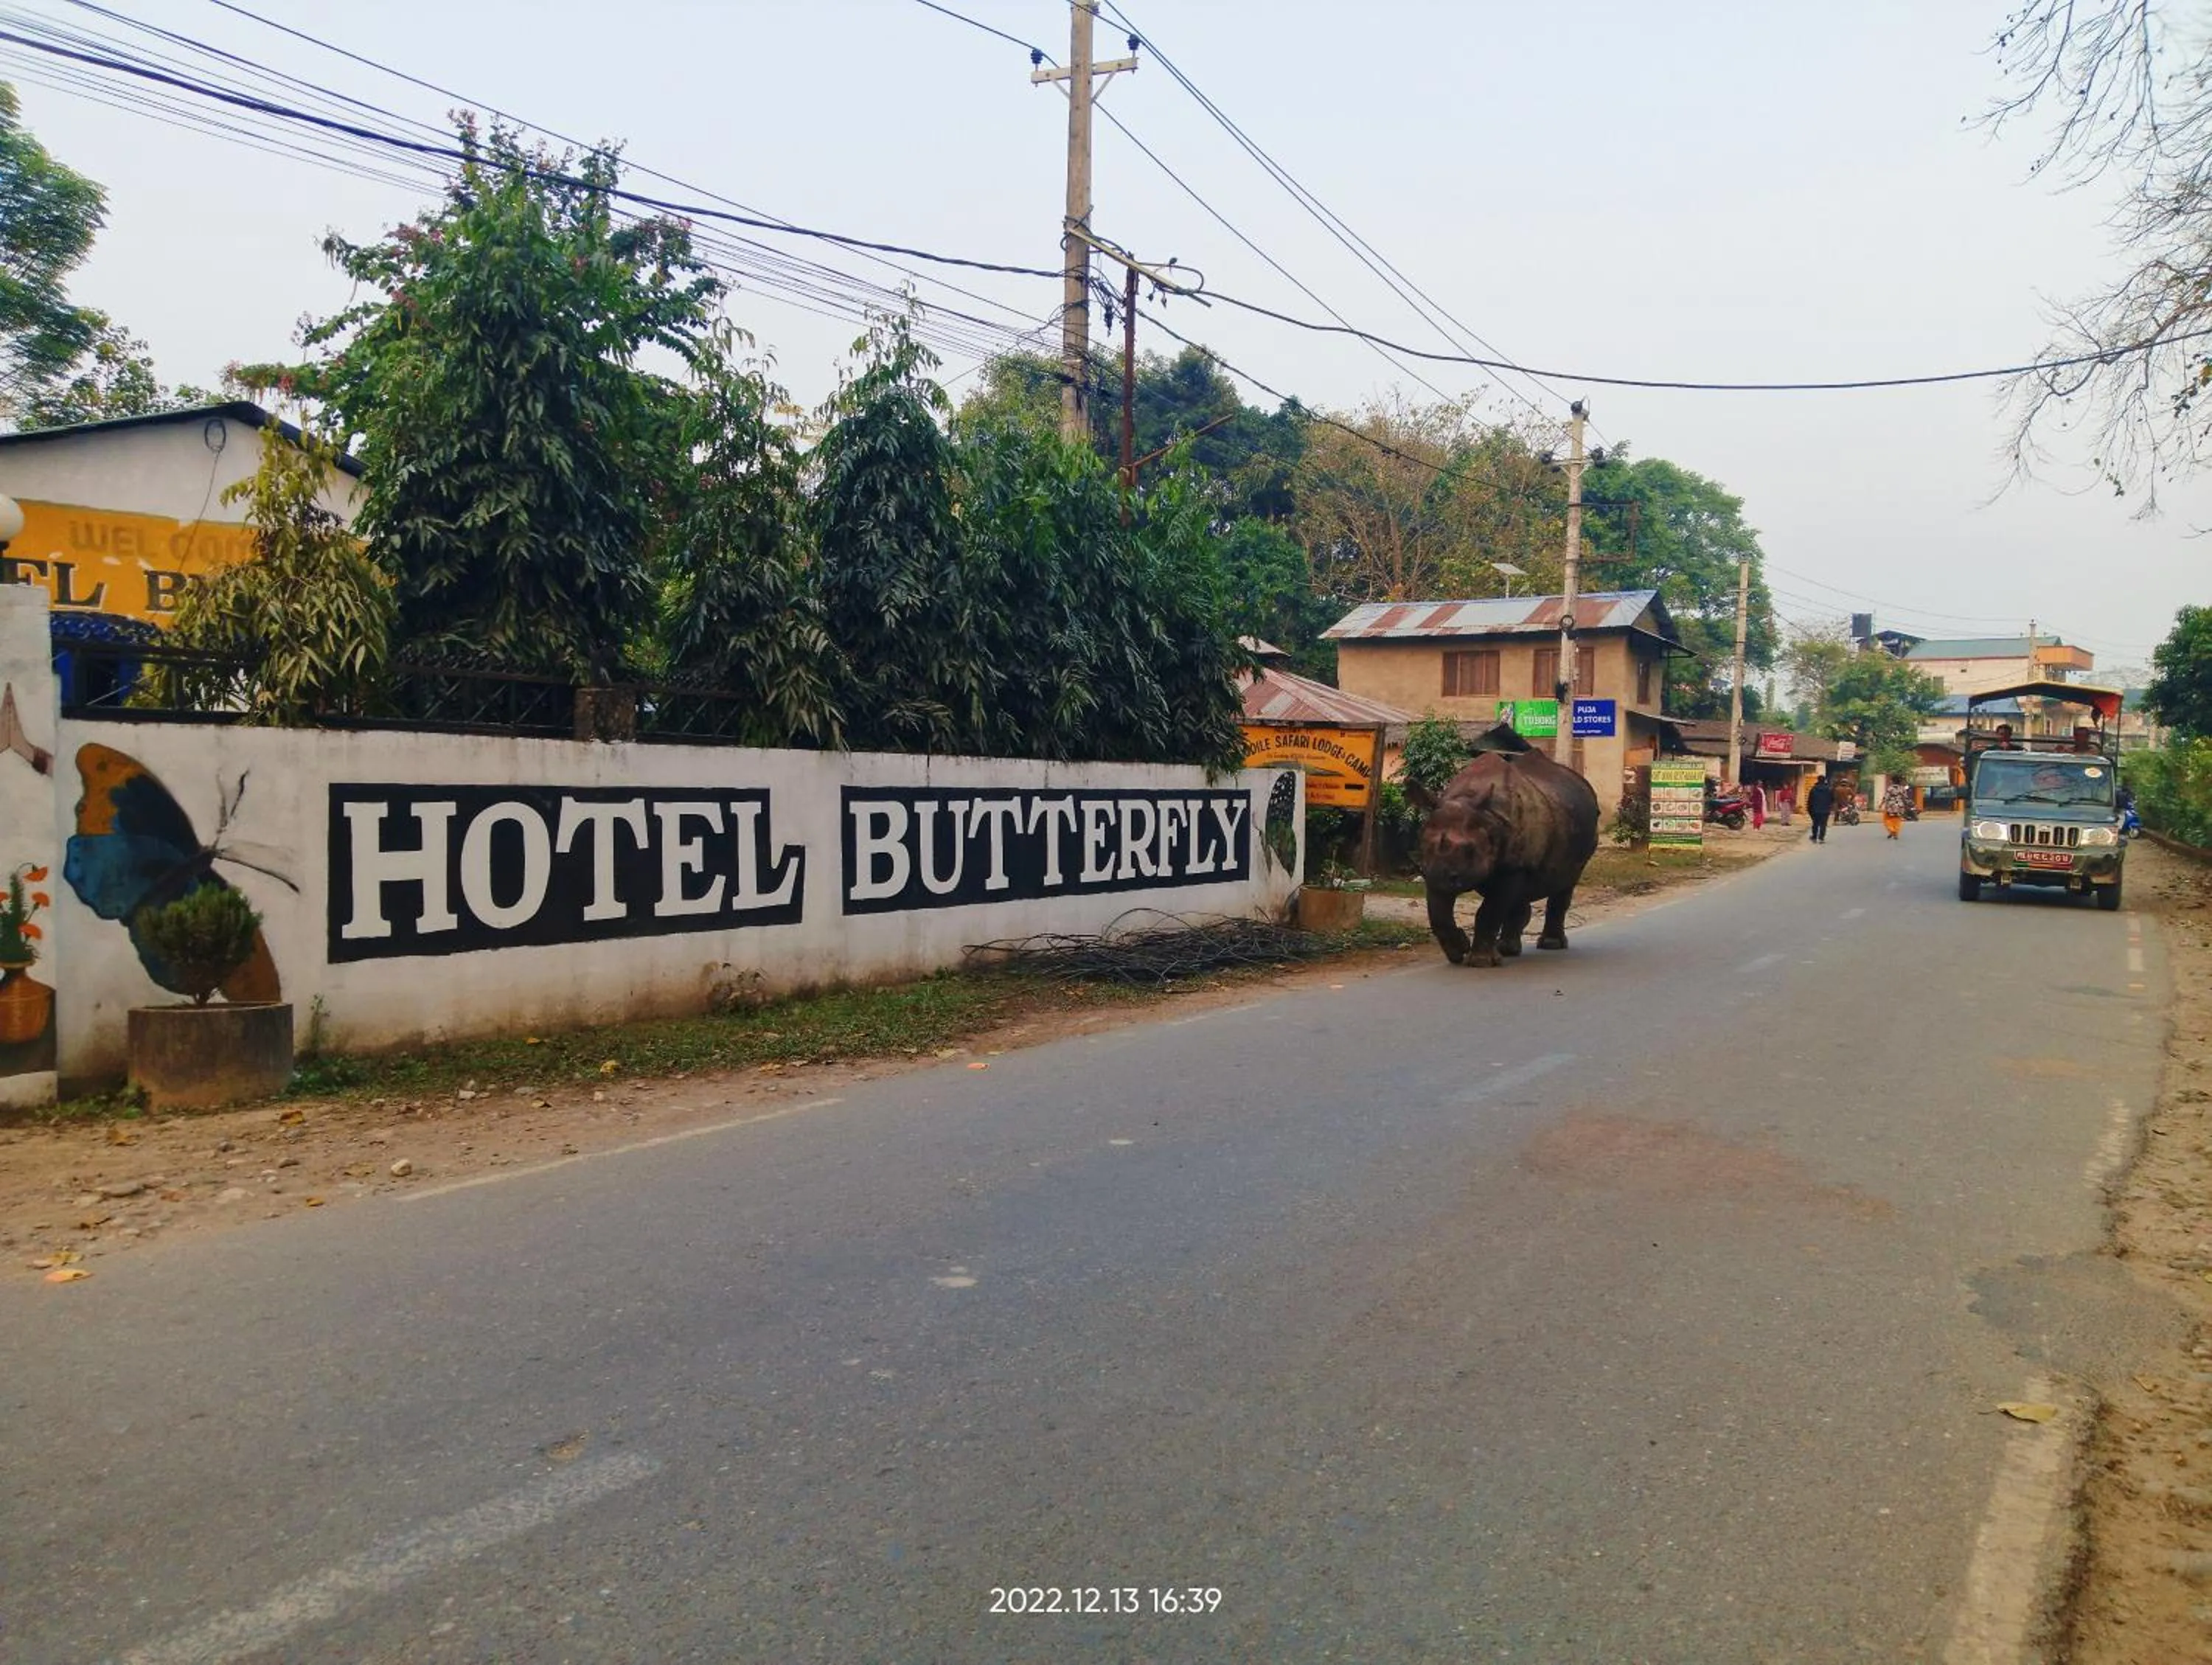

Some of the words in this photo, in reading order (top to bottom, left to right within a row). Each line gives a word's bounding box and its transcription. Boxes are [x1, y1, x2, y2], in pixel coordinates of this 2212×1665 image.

[1583, 715, 1611, 723] STORES
[1275, 734, 1310, 748] SAFARI
[1312, 737, 1343, 759] LODGE
[341, 796, 800, 939] HOTEL
[849, 794, 1246, 900] BUTTERFLY
